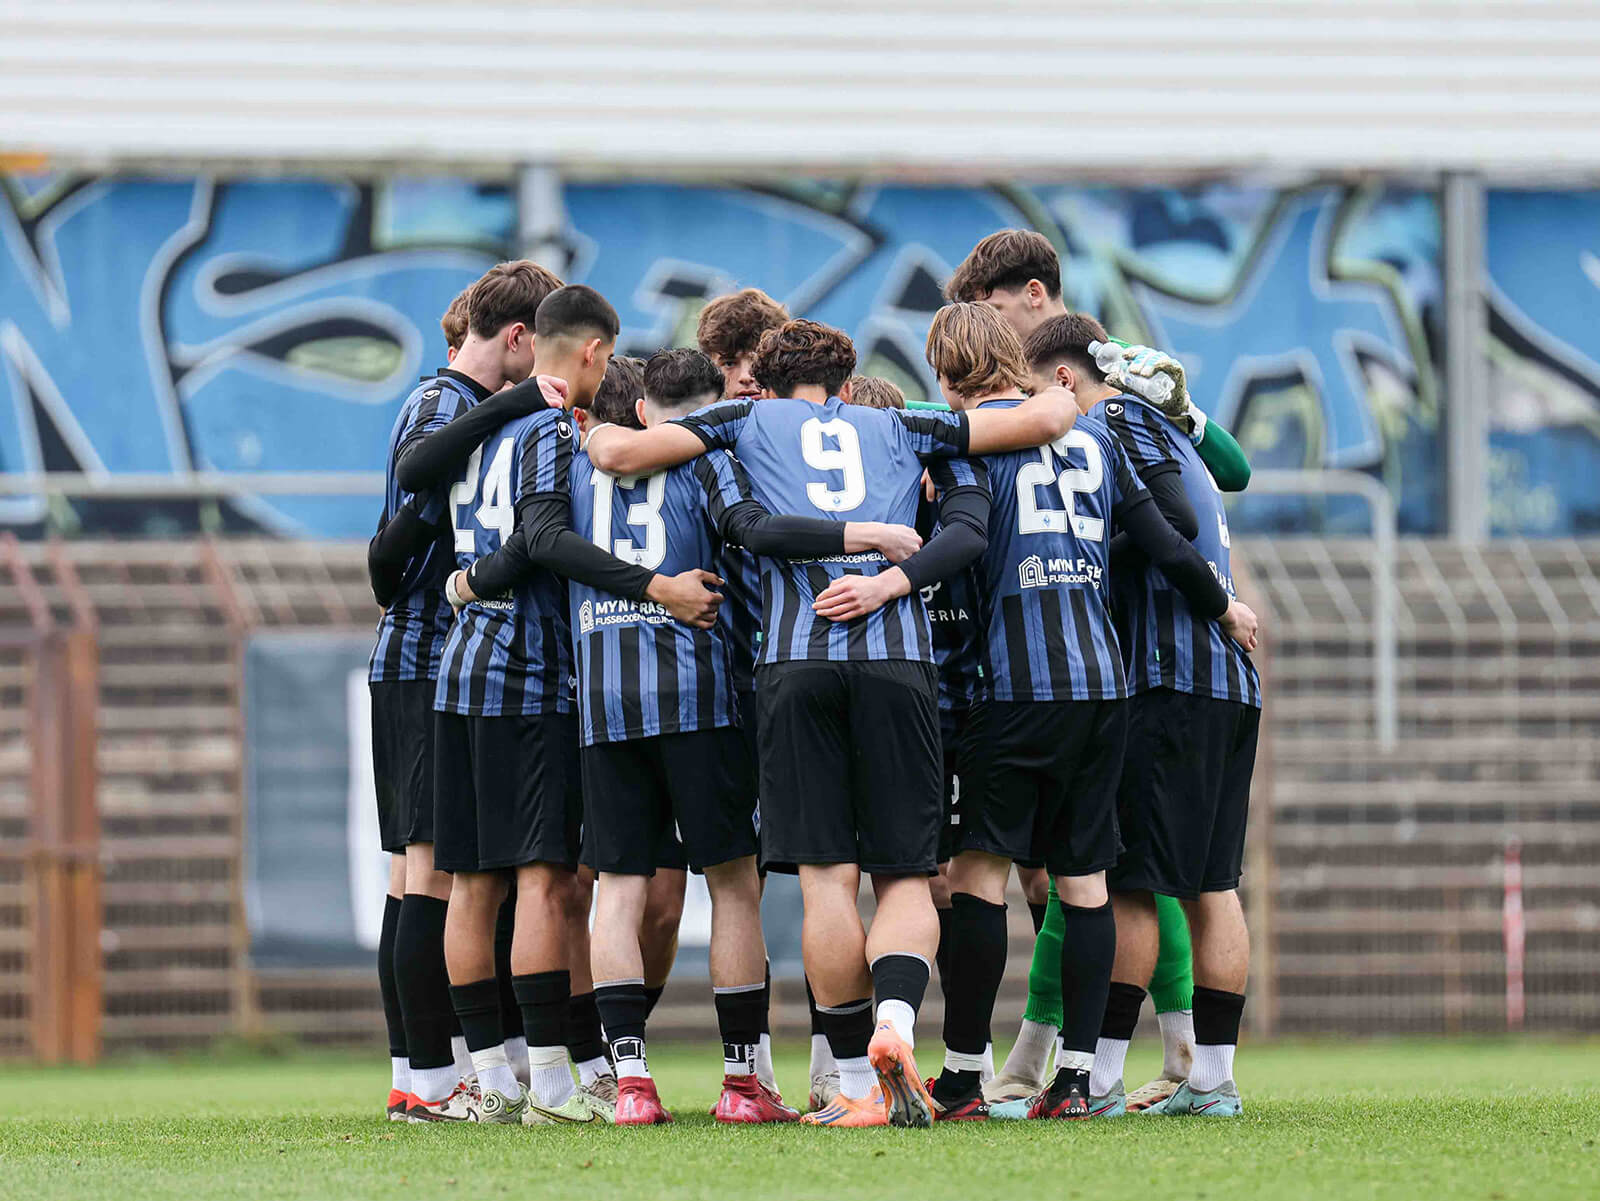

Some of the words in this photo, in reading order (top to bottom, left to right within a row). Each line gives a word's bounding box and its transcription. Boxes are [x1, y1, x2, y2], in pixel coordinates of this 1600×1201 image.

[449, 437, 515, 553] 24
[801, 416, 866, 512] 9
[1016, 429, 1104, 542] 22
[590, 467, 667, 570] 13
[1048, 558, 1074, 573] MYN
[595, 599, 628, 616] MYN
[1064, 1107, 1086, 1115] COPA
